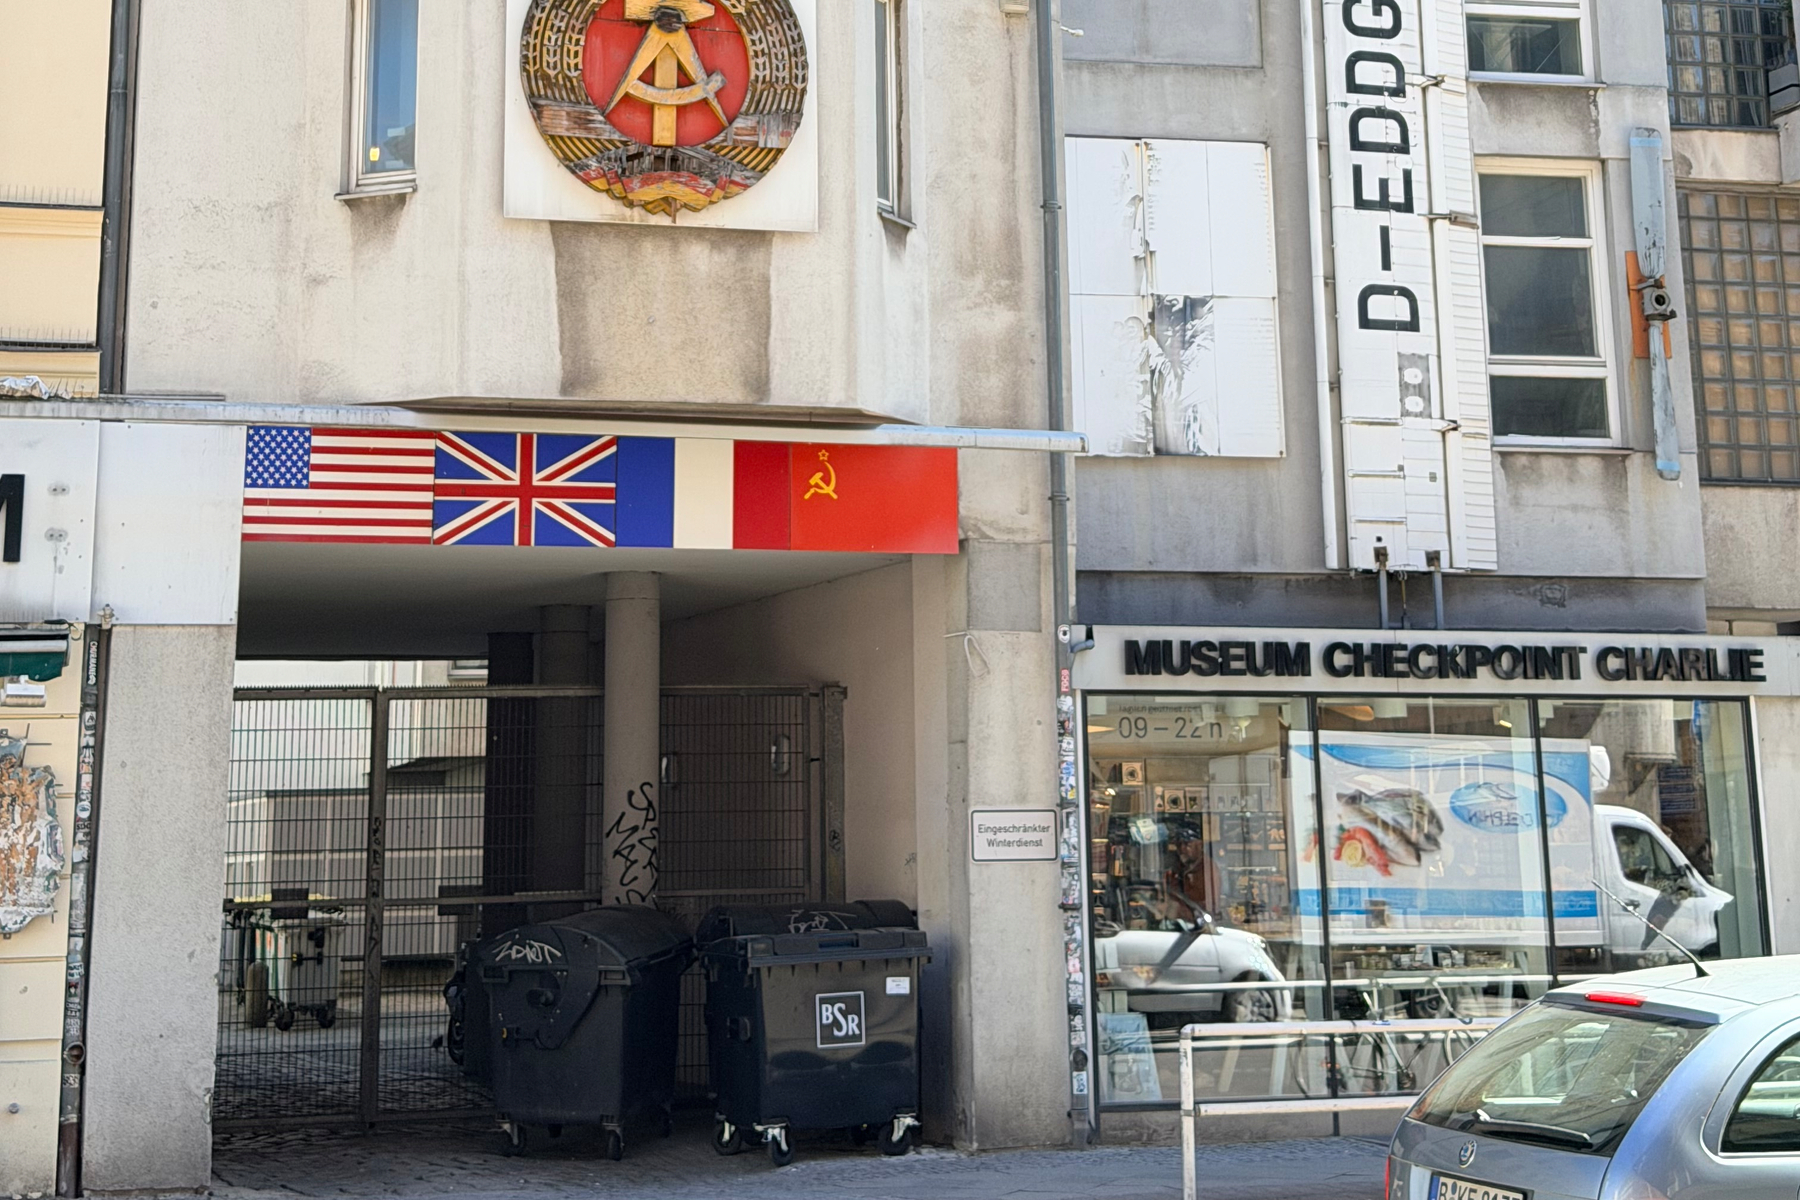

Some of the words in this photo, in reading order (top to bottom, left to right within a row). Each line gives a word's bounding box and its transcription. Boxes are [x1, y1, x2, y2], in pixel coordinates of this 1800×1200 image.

[1124, 639, 1311, 677] MUSEUM
[1322, 641, 1588, 680] CHECKPOINT
[1596, 646, 1767, 682] CHARLIE
[1118, 716, 1147, 739] 09
[977, 823, 1051, 835] Eingeschränkter
[986, 837, 1043, 848] Winterdienst
[821, 1002, 860, 1037] BSR
